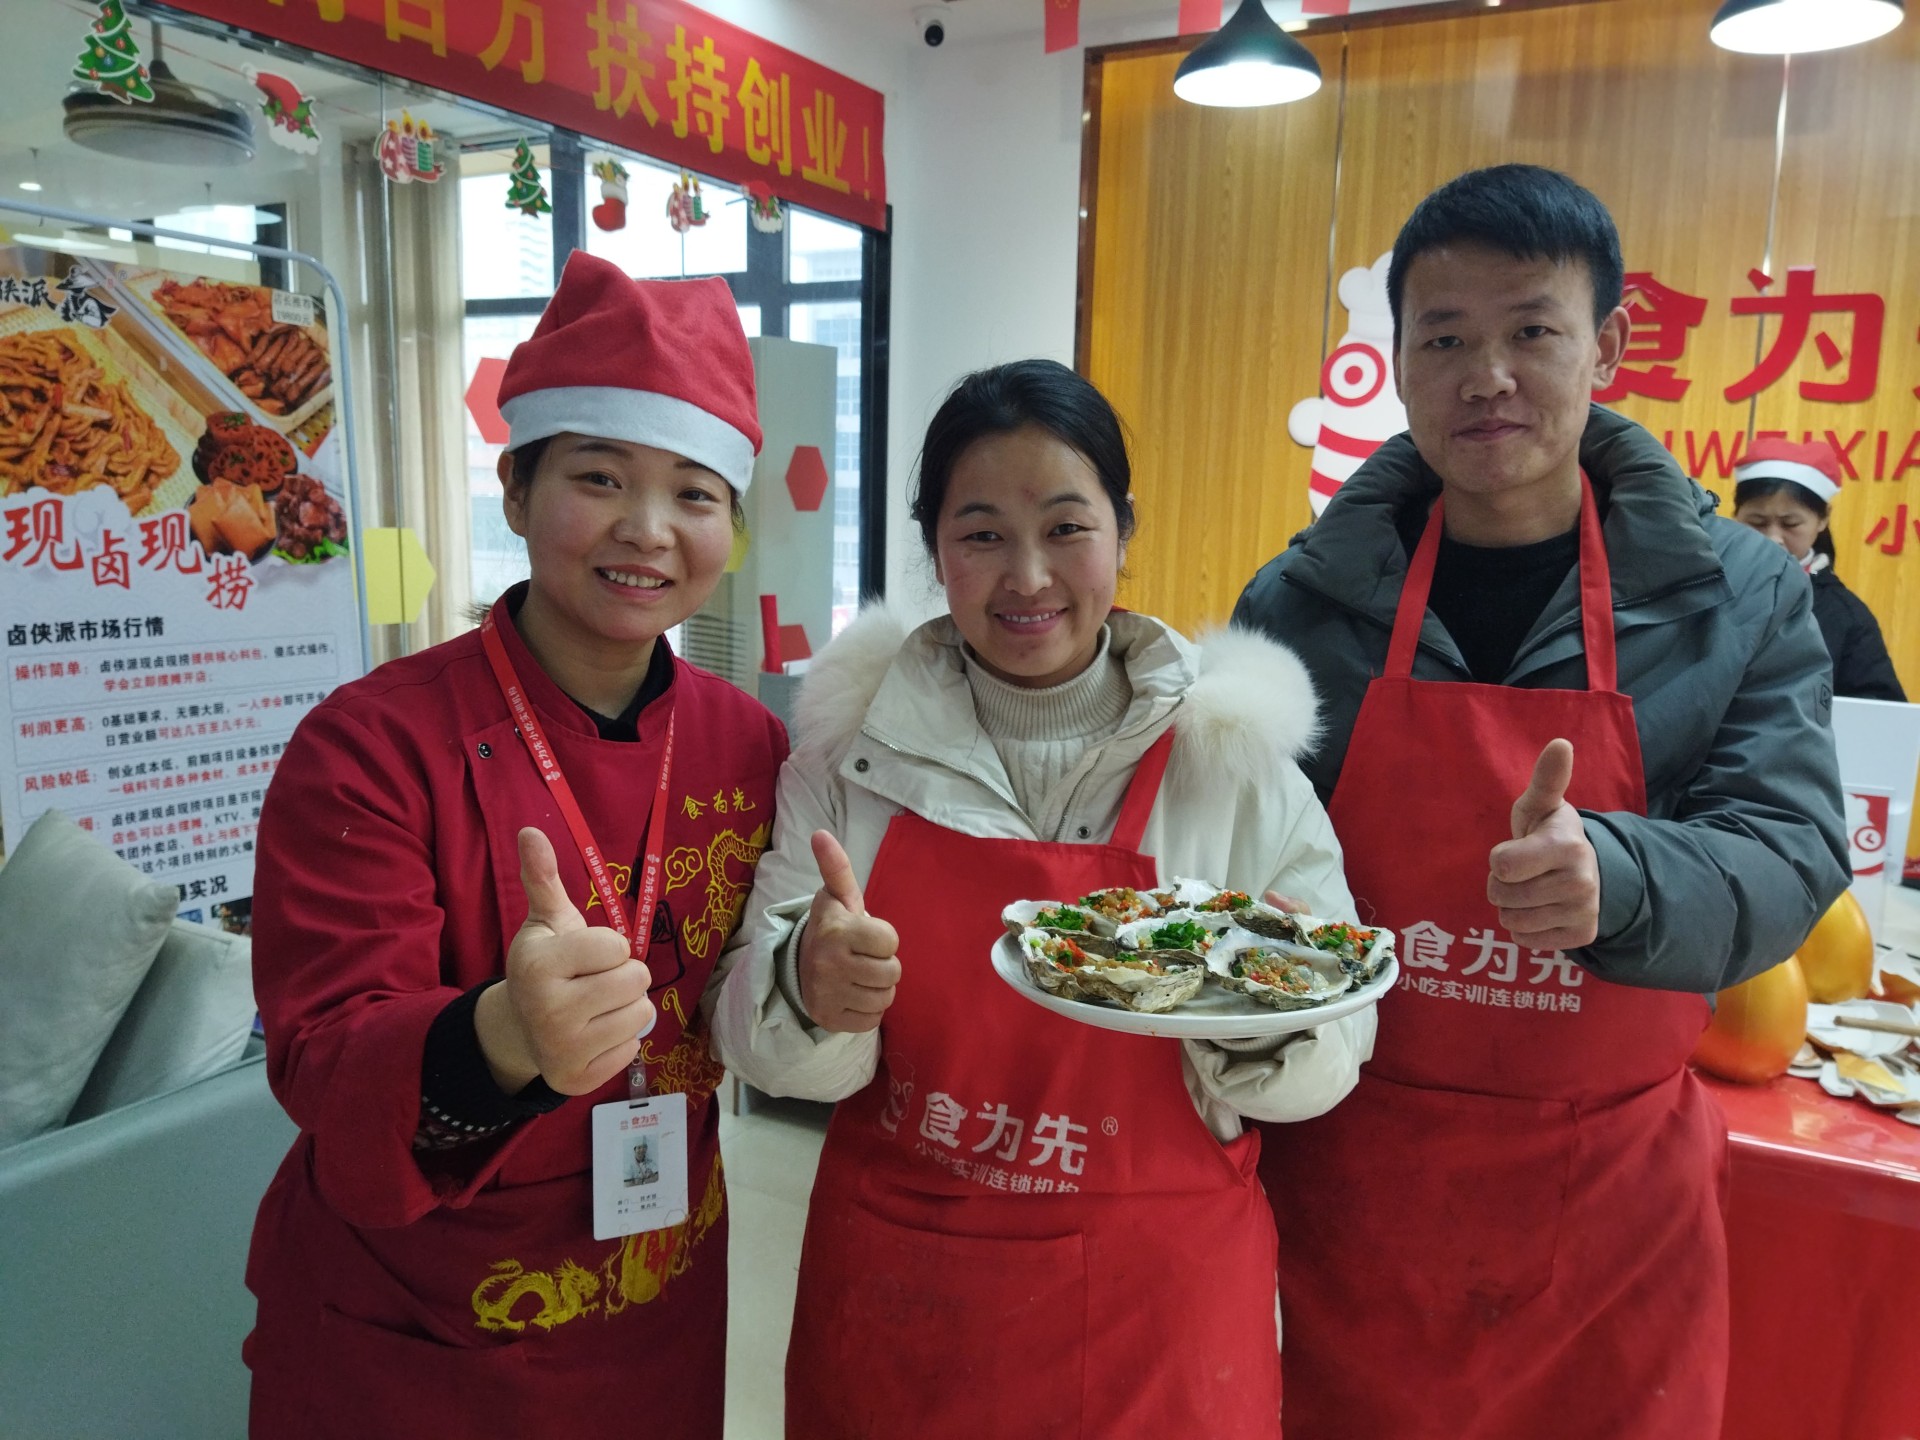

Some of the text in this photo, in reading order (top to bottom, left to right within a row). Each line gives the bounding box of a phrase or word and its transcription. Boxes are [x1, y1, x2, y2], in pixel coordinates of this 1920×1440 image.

[1591, 265, 1920, 403] 食为
[7, 616, 165, 646] 卤侠派市场行情
[1398, 973, 1581, 1013] 小吃实训连锁机构
[919, 1091, 1088, 1176] 食为先
